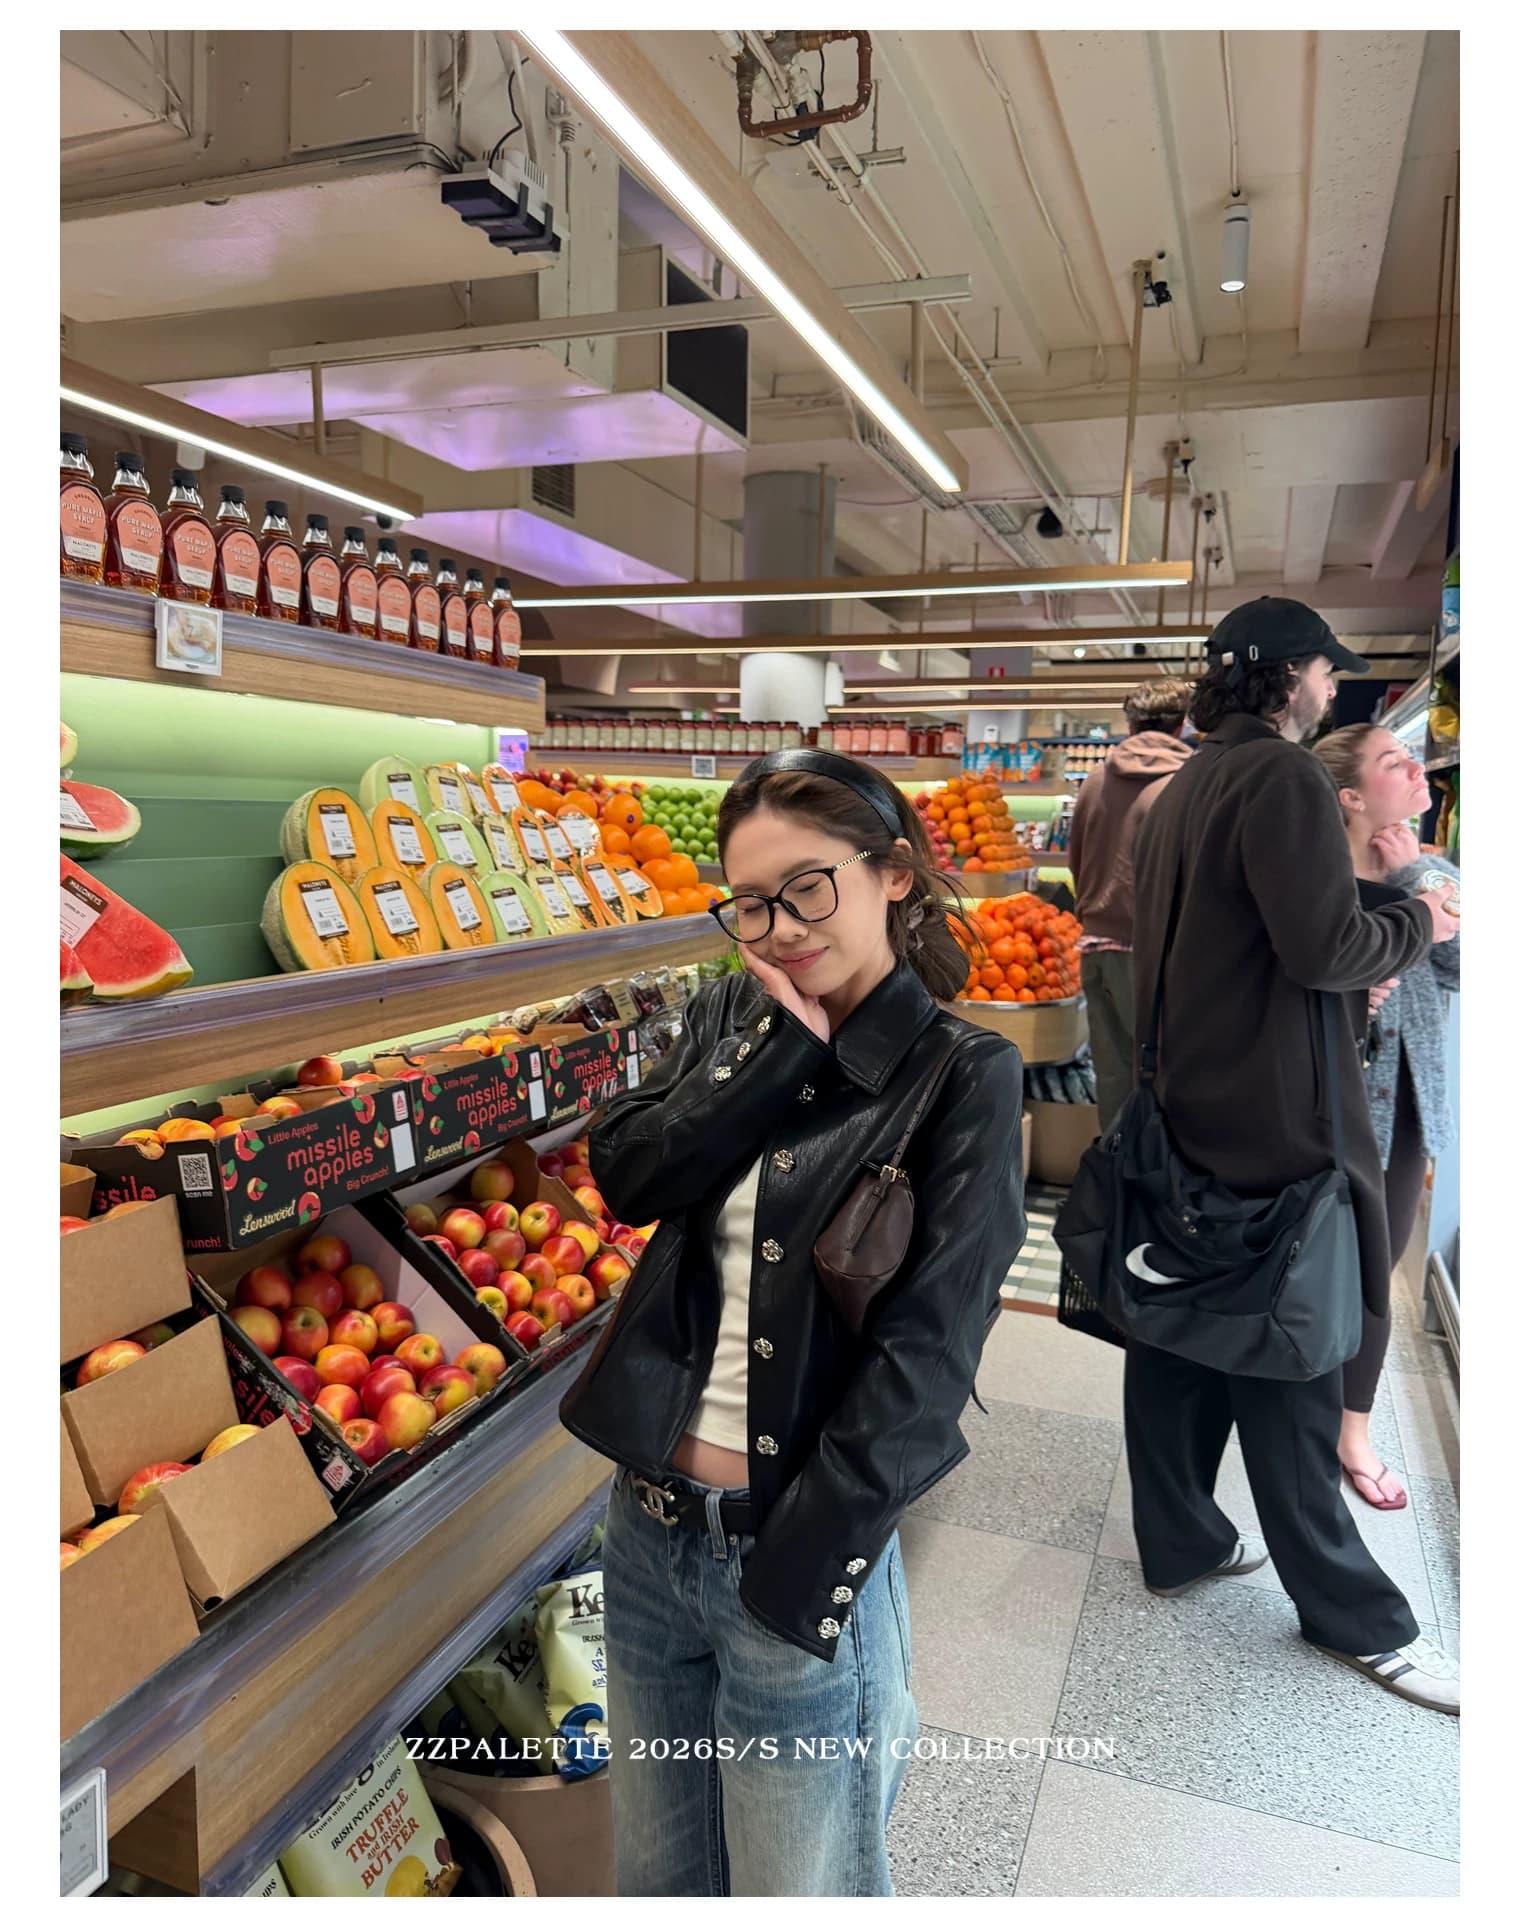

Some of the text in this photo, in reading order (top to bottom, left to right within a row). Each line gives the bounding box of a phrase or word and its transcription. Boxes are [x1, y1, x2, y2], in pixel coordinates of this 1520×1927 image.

[574, 1050, 611, 1079] missile
[456, 1076, 508, 1113] missile
[468, 1096, 518, 1130] apples
[267, 1121, 320, 1145] Little Apples
[286, 1122, 361, 1172] missile
[303, 1146, 375, 1190] apples
[346, 1164, 391, 1191] Big Crunch!
[94, 1175, 157, 1211] ssile
[239, 1199, 297, 1236] Lenswood
[186, 1236, 222, 1249] runch!
[566, 1583, 605, 1619] Ke
[309, 1813, 333, 1840] Grown
[331, 1799, 349, 1818] with
[343, 1787, 359, 1806] love
[375, 1758, 385, 1769] in
[330, 1823, 355, 1850] IRISH
[352, 1788, 385, 1827] POTATO
[384, 1764, 402, 1792] CHIPS
[346, 1787, 410, 1863] TRUFFLE
[367, 1814, 404, 1860] and IRISH
[361, 1816, 420, 1890] BUTTER
